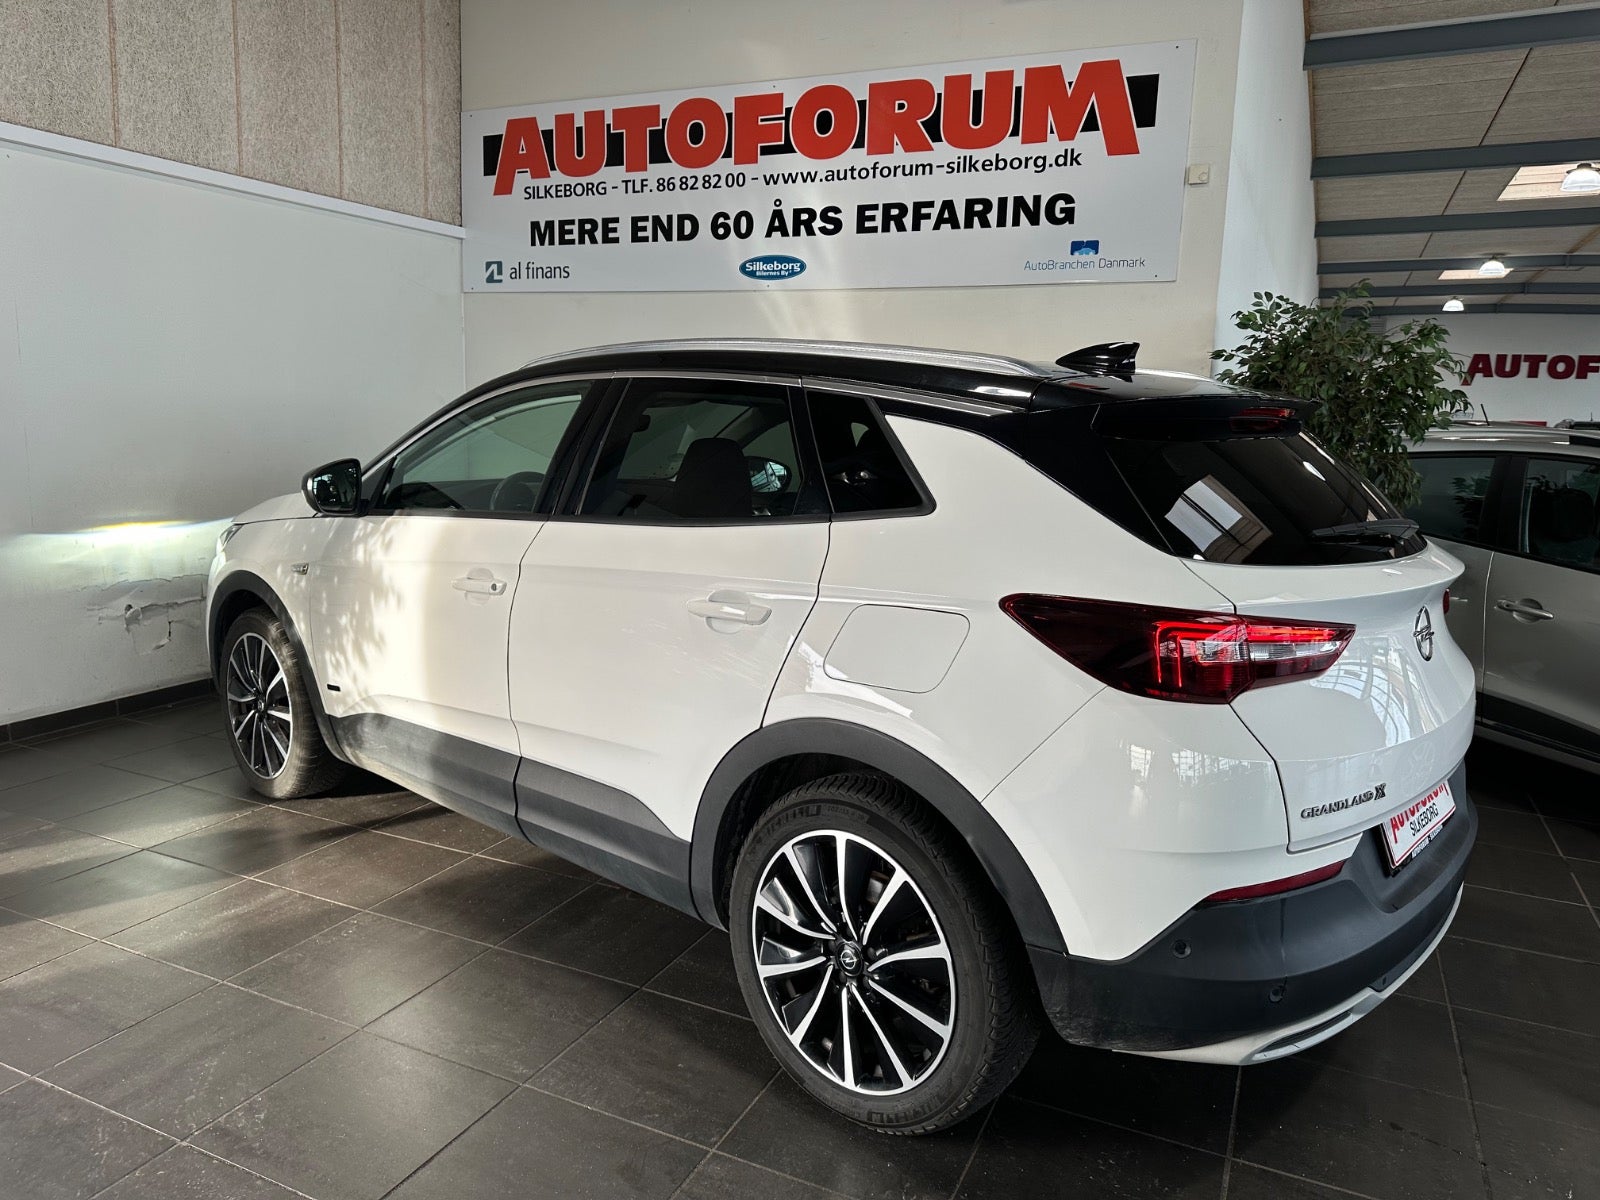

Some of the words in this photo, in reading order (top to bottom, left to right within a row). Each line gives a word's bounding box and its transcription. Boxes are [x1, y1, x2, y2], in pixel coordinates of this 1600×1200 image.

[492, 59, 1140, 196] AUTOFORUM
[523, 181, 607, 200] SILKEBORG
[621, 179, 653, 194] TLF.
[763, 148, 1083, 186] www.autoforum-silkeborg.dk
[530, 216, 620, 246] MERE
[630, 213, 700, 243] END
[710, 210, 754, 240] 60
[764, 198, 843, 238] ÅRS
[856, 192, 1076, 235] ERFARING
[509, 261, 521, 280] al
[525, 260, 570, 279] finans
[745, 260, 801, 272] Silkeborg
[1023, 258, 1095, 271] AutoBranchen
[1098, 256, 1146, 269] Danmark
[1460, 353, 1600, 386] AUTOF
[1300, 790, 1374, 819] GRANDLAND
[1409, 802, 1439, 836] SILKEBORG
